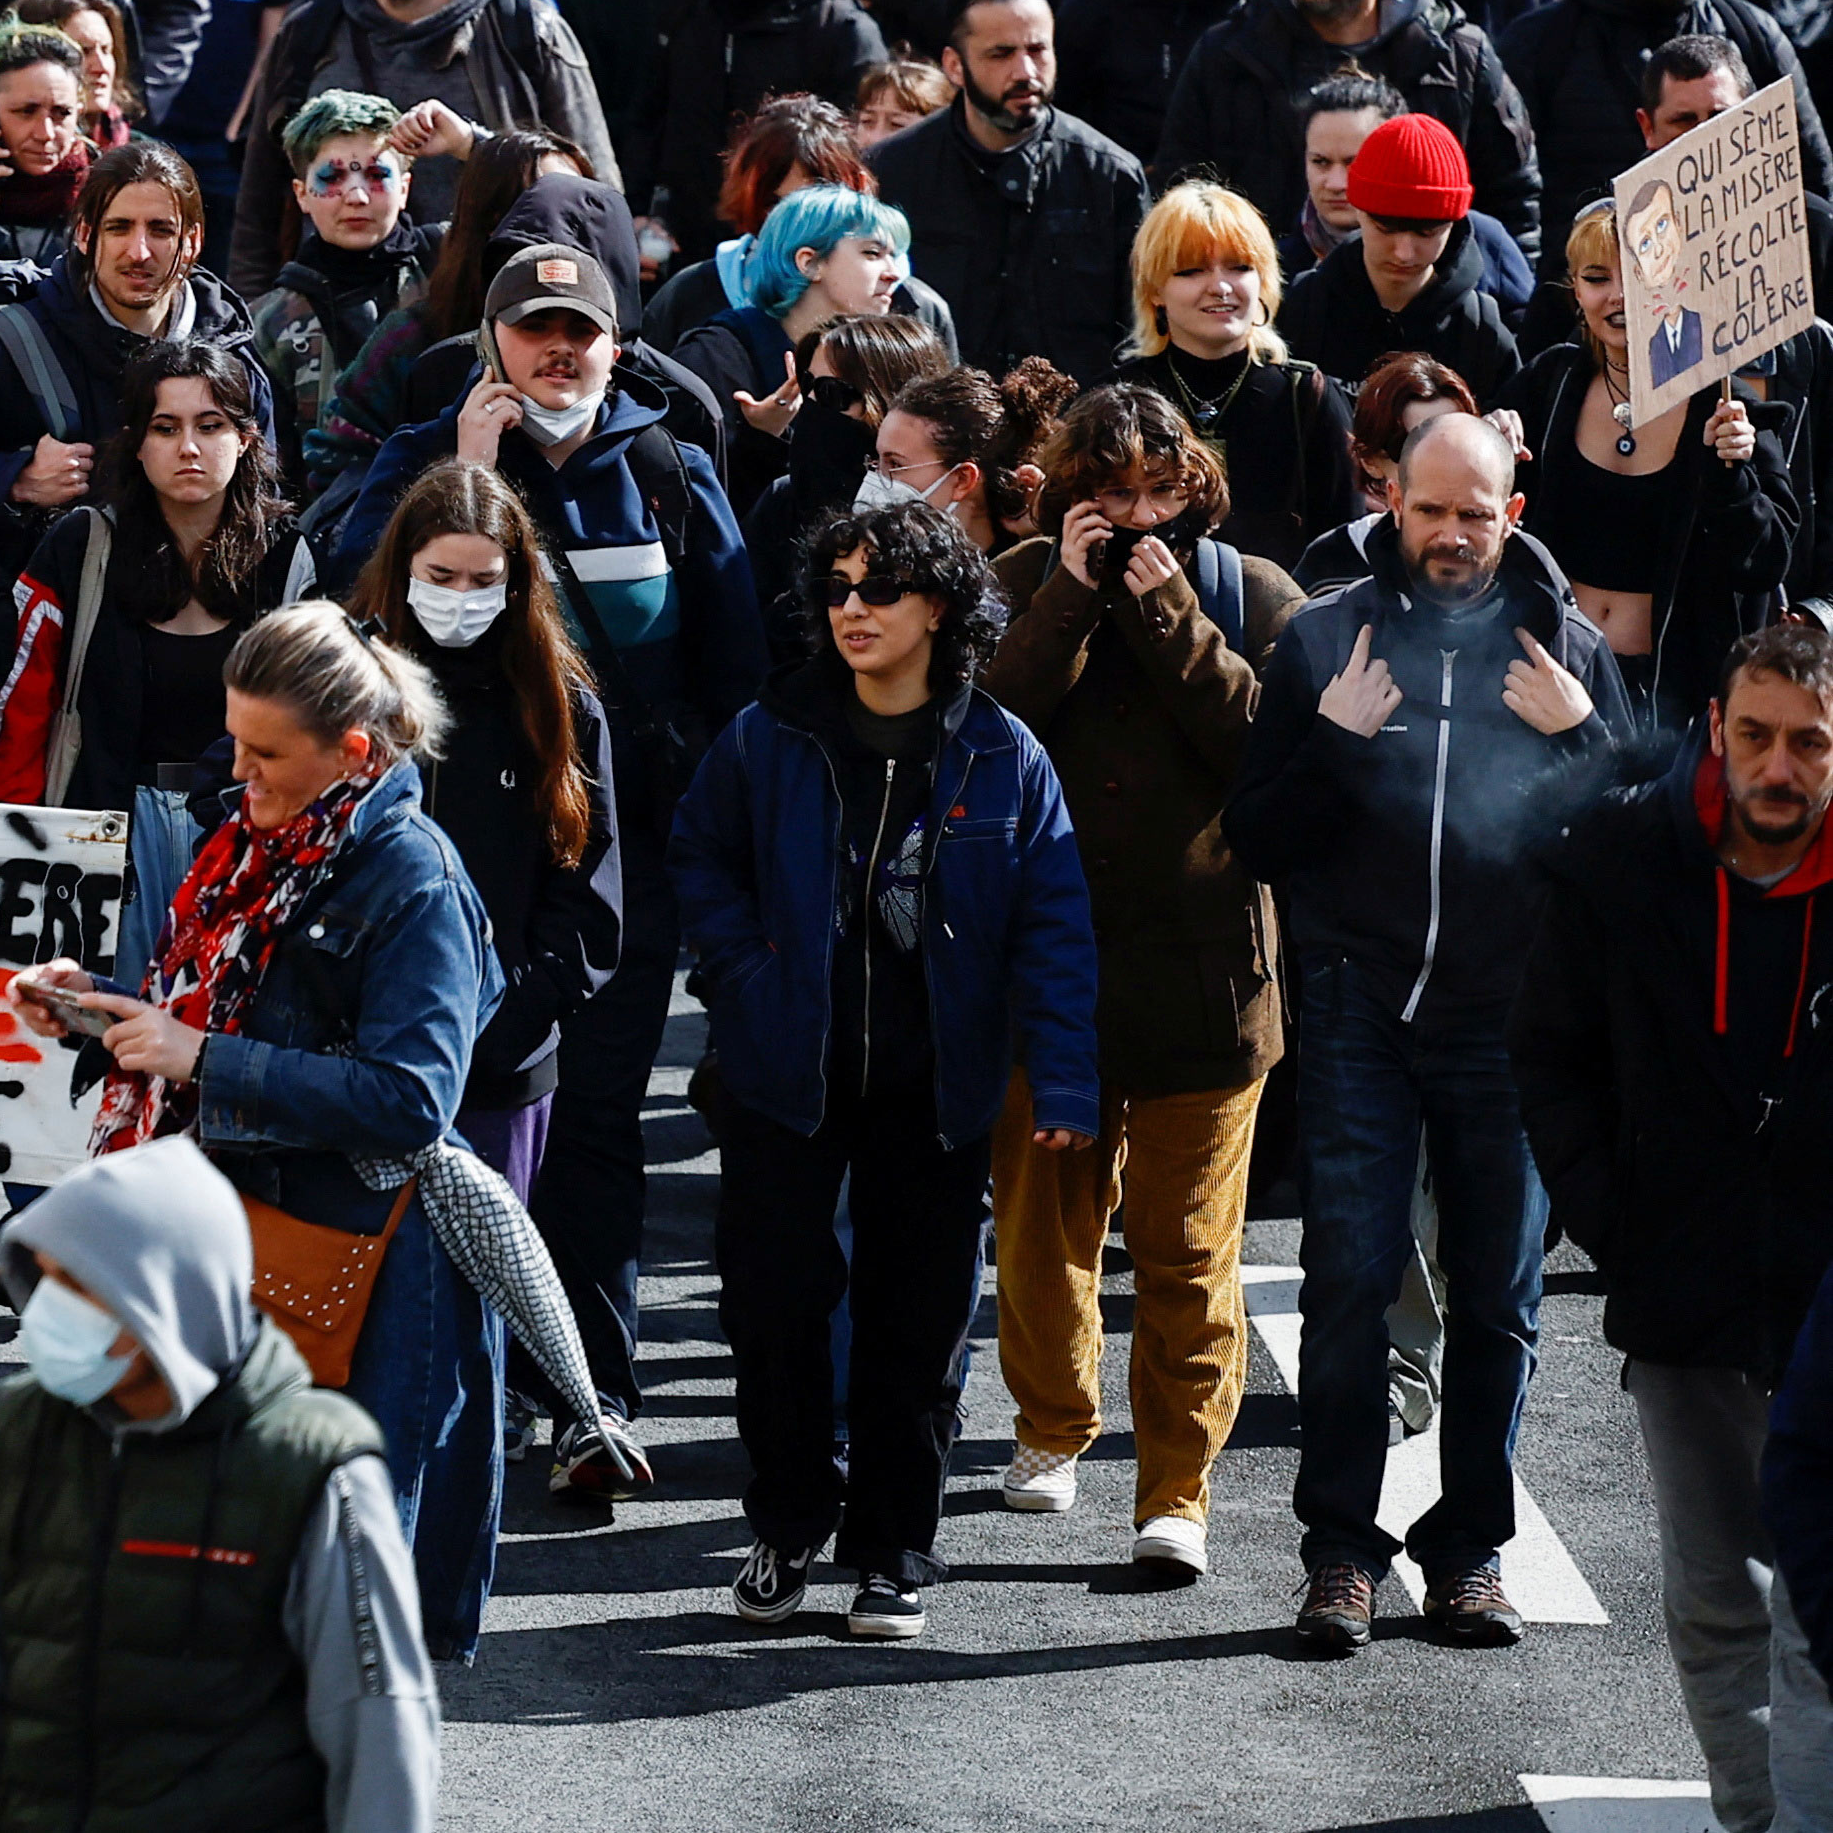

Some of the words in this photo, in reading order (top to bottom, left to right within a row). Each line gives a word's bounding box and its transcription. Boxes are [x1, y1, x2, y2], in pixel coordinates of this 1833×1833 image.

[1676, 136, 1722, 196] QUI
[1729, 102, 1790, 166] SÈME
[1684, 193, 1715, 242] LA
[1722, 144, 1799, 222] MISÈRE
[1699, 195, 1805, 293] RÉCOLTE
[1735, 263, 1766, 313] LA
[1712, 275, 1809, 356] COLÈRE
